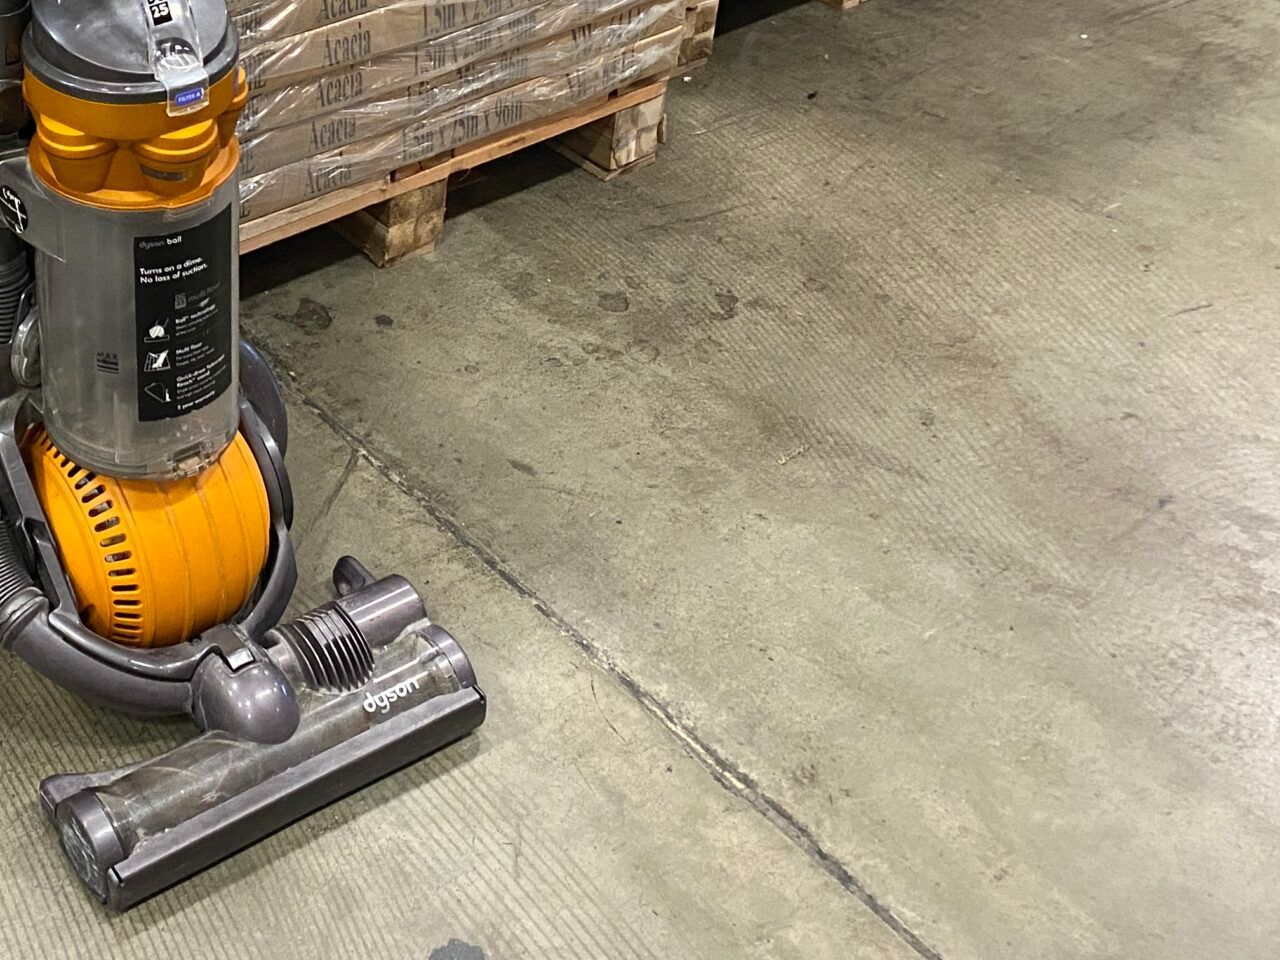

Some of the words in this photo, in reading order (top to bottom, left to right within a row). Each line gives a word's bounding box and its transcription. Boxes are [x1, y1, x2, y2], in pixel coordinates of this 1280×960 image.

[151, 4, 169, 18] 25
[323, 21, 371, 68] Acacia
[177, 93, 195, 103] FILTER
[139, 240, 164, 249] dyson
[167, 235, 182, 245] ball
[139, 267, 162, 275] Turns
[172, 271, 180, 279] of
[363, 678, 420, 714] dyson
